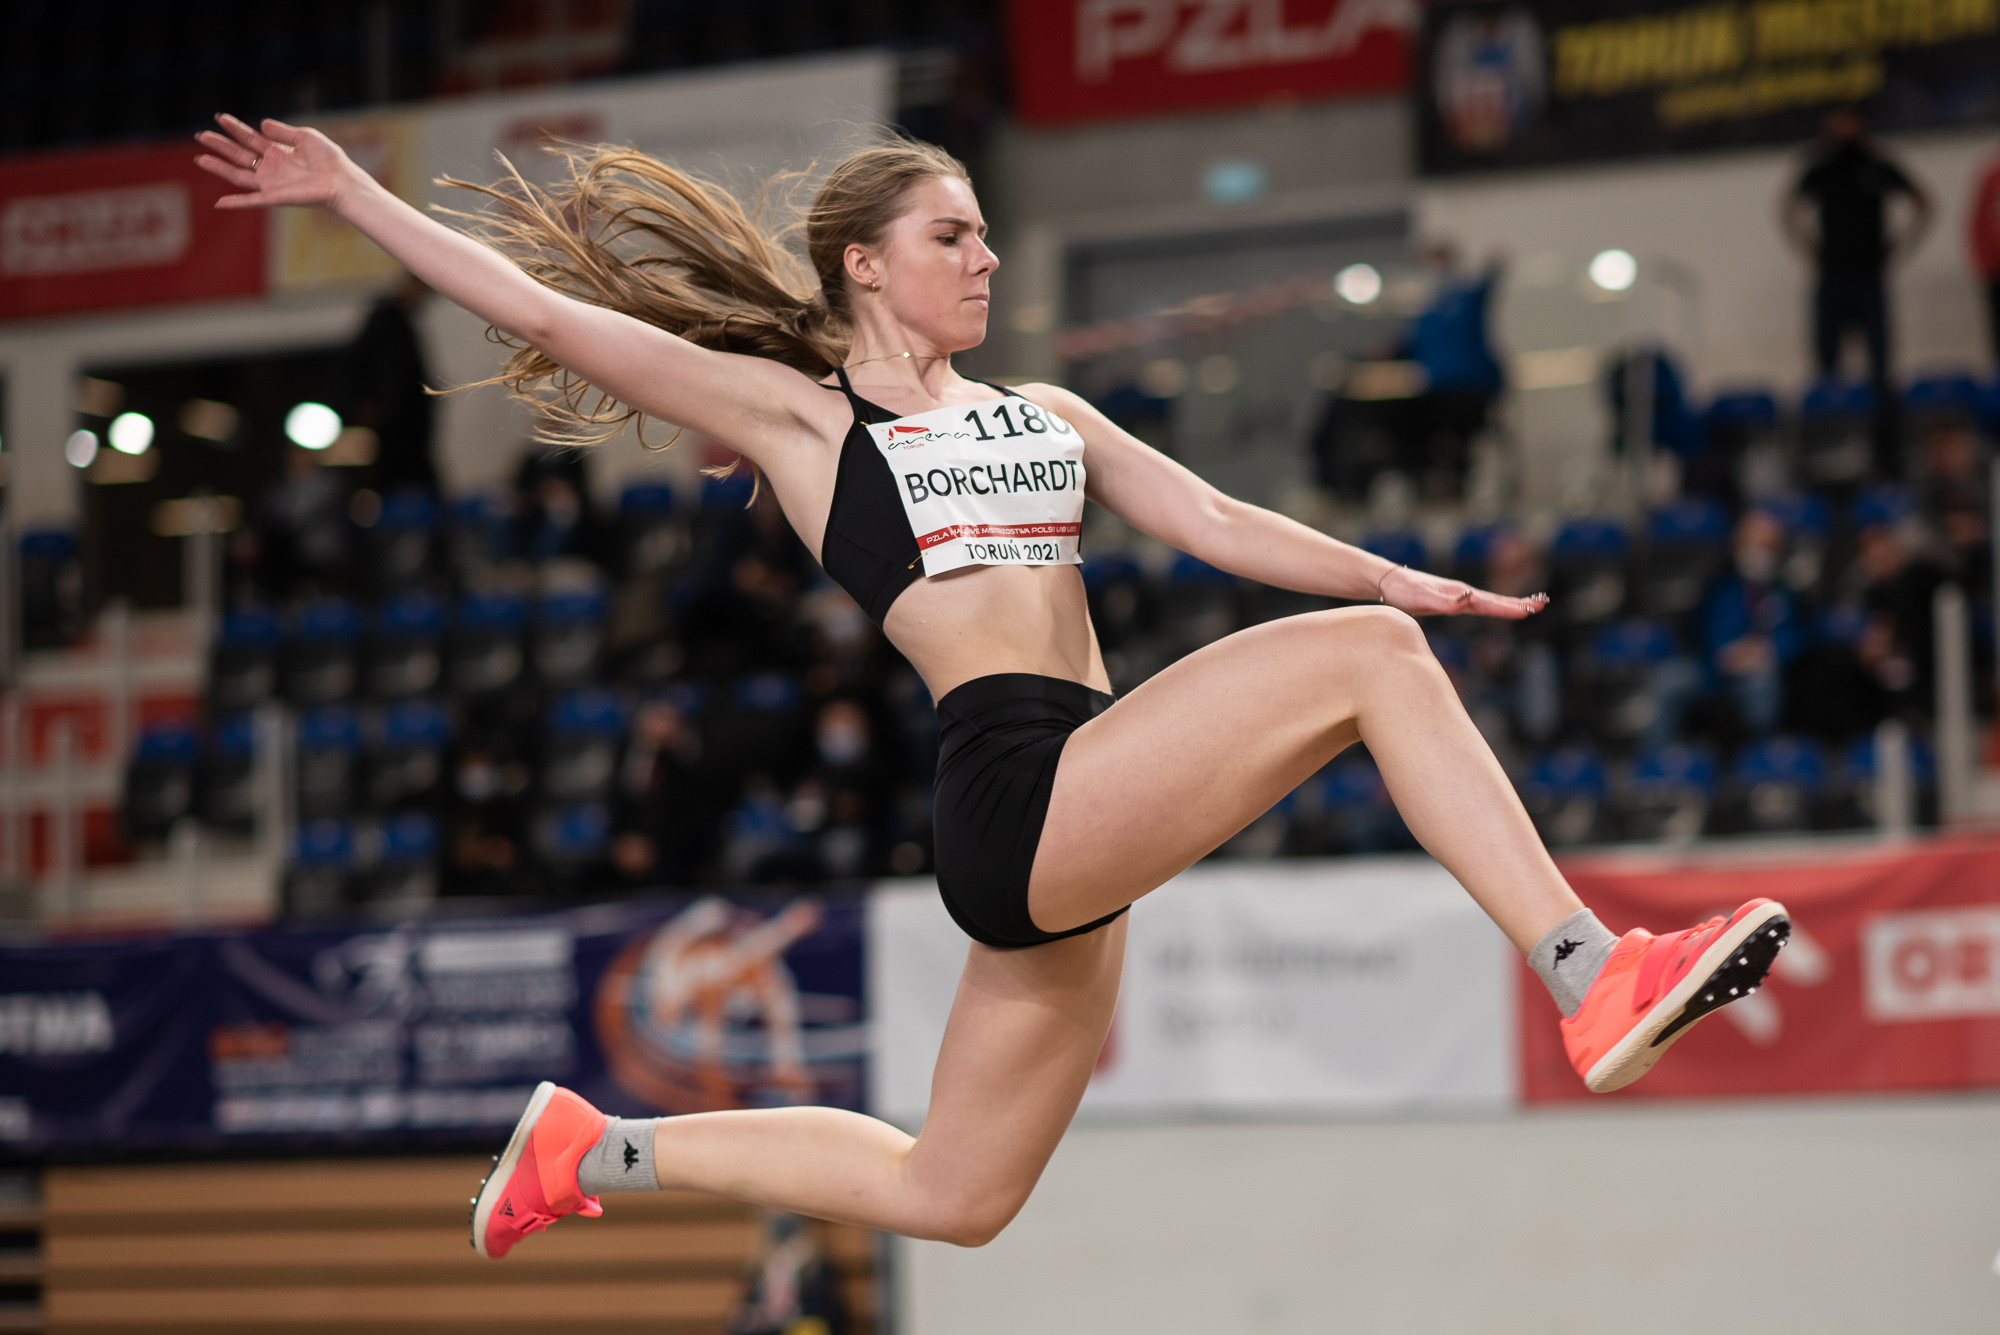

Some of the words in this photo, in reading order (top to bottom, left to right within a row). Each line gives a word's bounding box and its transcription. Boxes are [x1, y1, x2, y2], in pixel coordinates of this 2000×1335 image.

[888, 432, 970, 450] arena
[904, 460, 1078, 504] BORCHARDT
[926, 531, 949, 544] PZLA
[965, 540, 1022, 560] TORUŃ
[1023, 543, 1060, 560] 2021
